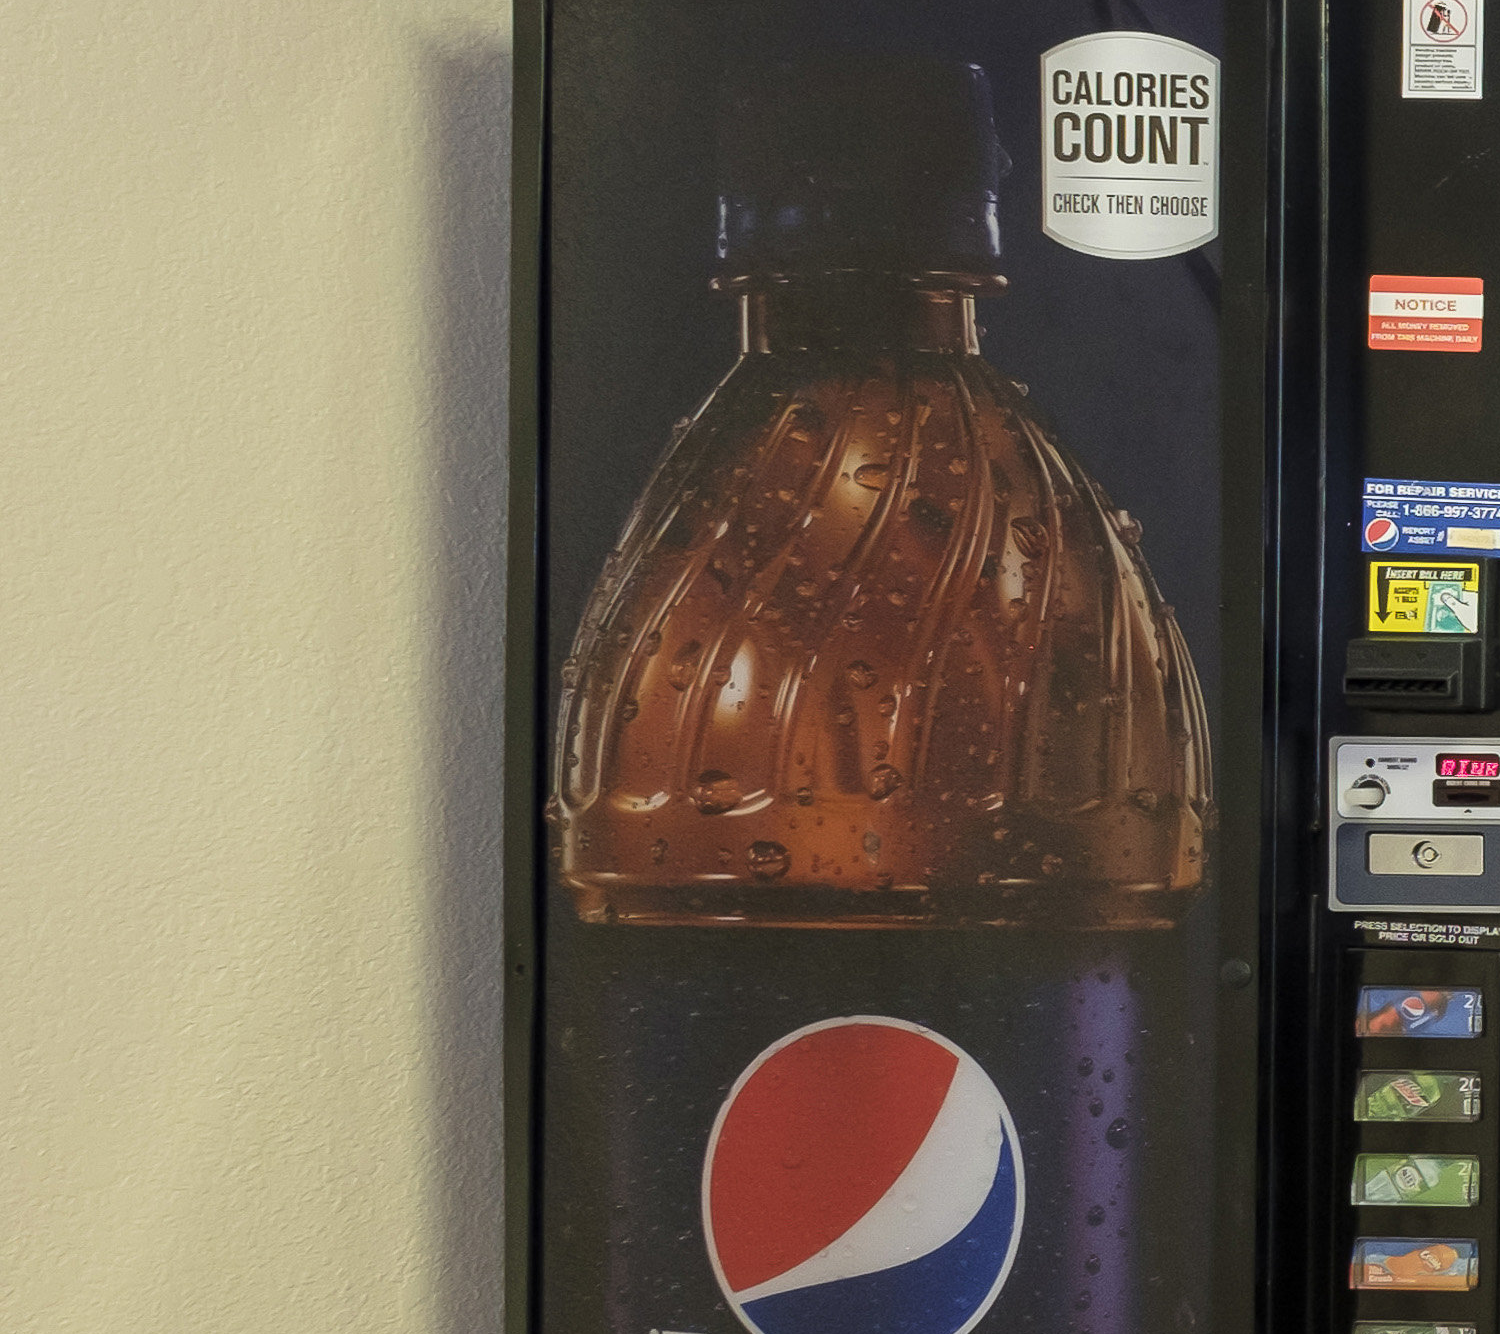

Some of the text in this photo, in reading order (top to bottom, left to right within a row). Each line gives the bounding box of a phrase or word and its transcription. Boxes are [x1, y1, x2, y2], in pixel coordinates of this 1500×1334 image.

[1052, 69, 1210, 110] CALORIES
[1054, 111, 1209, 166] COUNT
[1053, 193, 1208, 216] CHECK THEN CHOOSE
[1395, 298, 1457, 312] NOTICE
[1371, 333, 1395, 341] FROM
[1367, 483, 1394, 495] FOR
[1397, 485, 1446, 497] REPAIR
[1440, 570, 1465, 580] HERE
[1354, 920, 1388, 931] PRESS
[1390, 922, 1446, 933] SELECTION
[1448, 924, 1461, 934] TO
[1378, 931, 1480, 945] PRICE OR SOLD OUT
